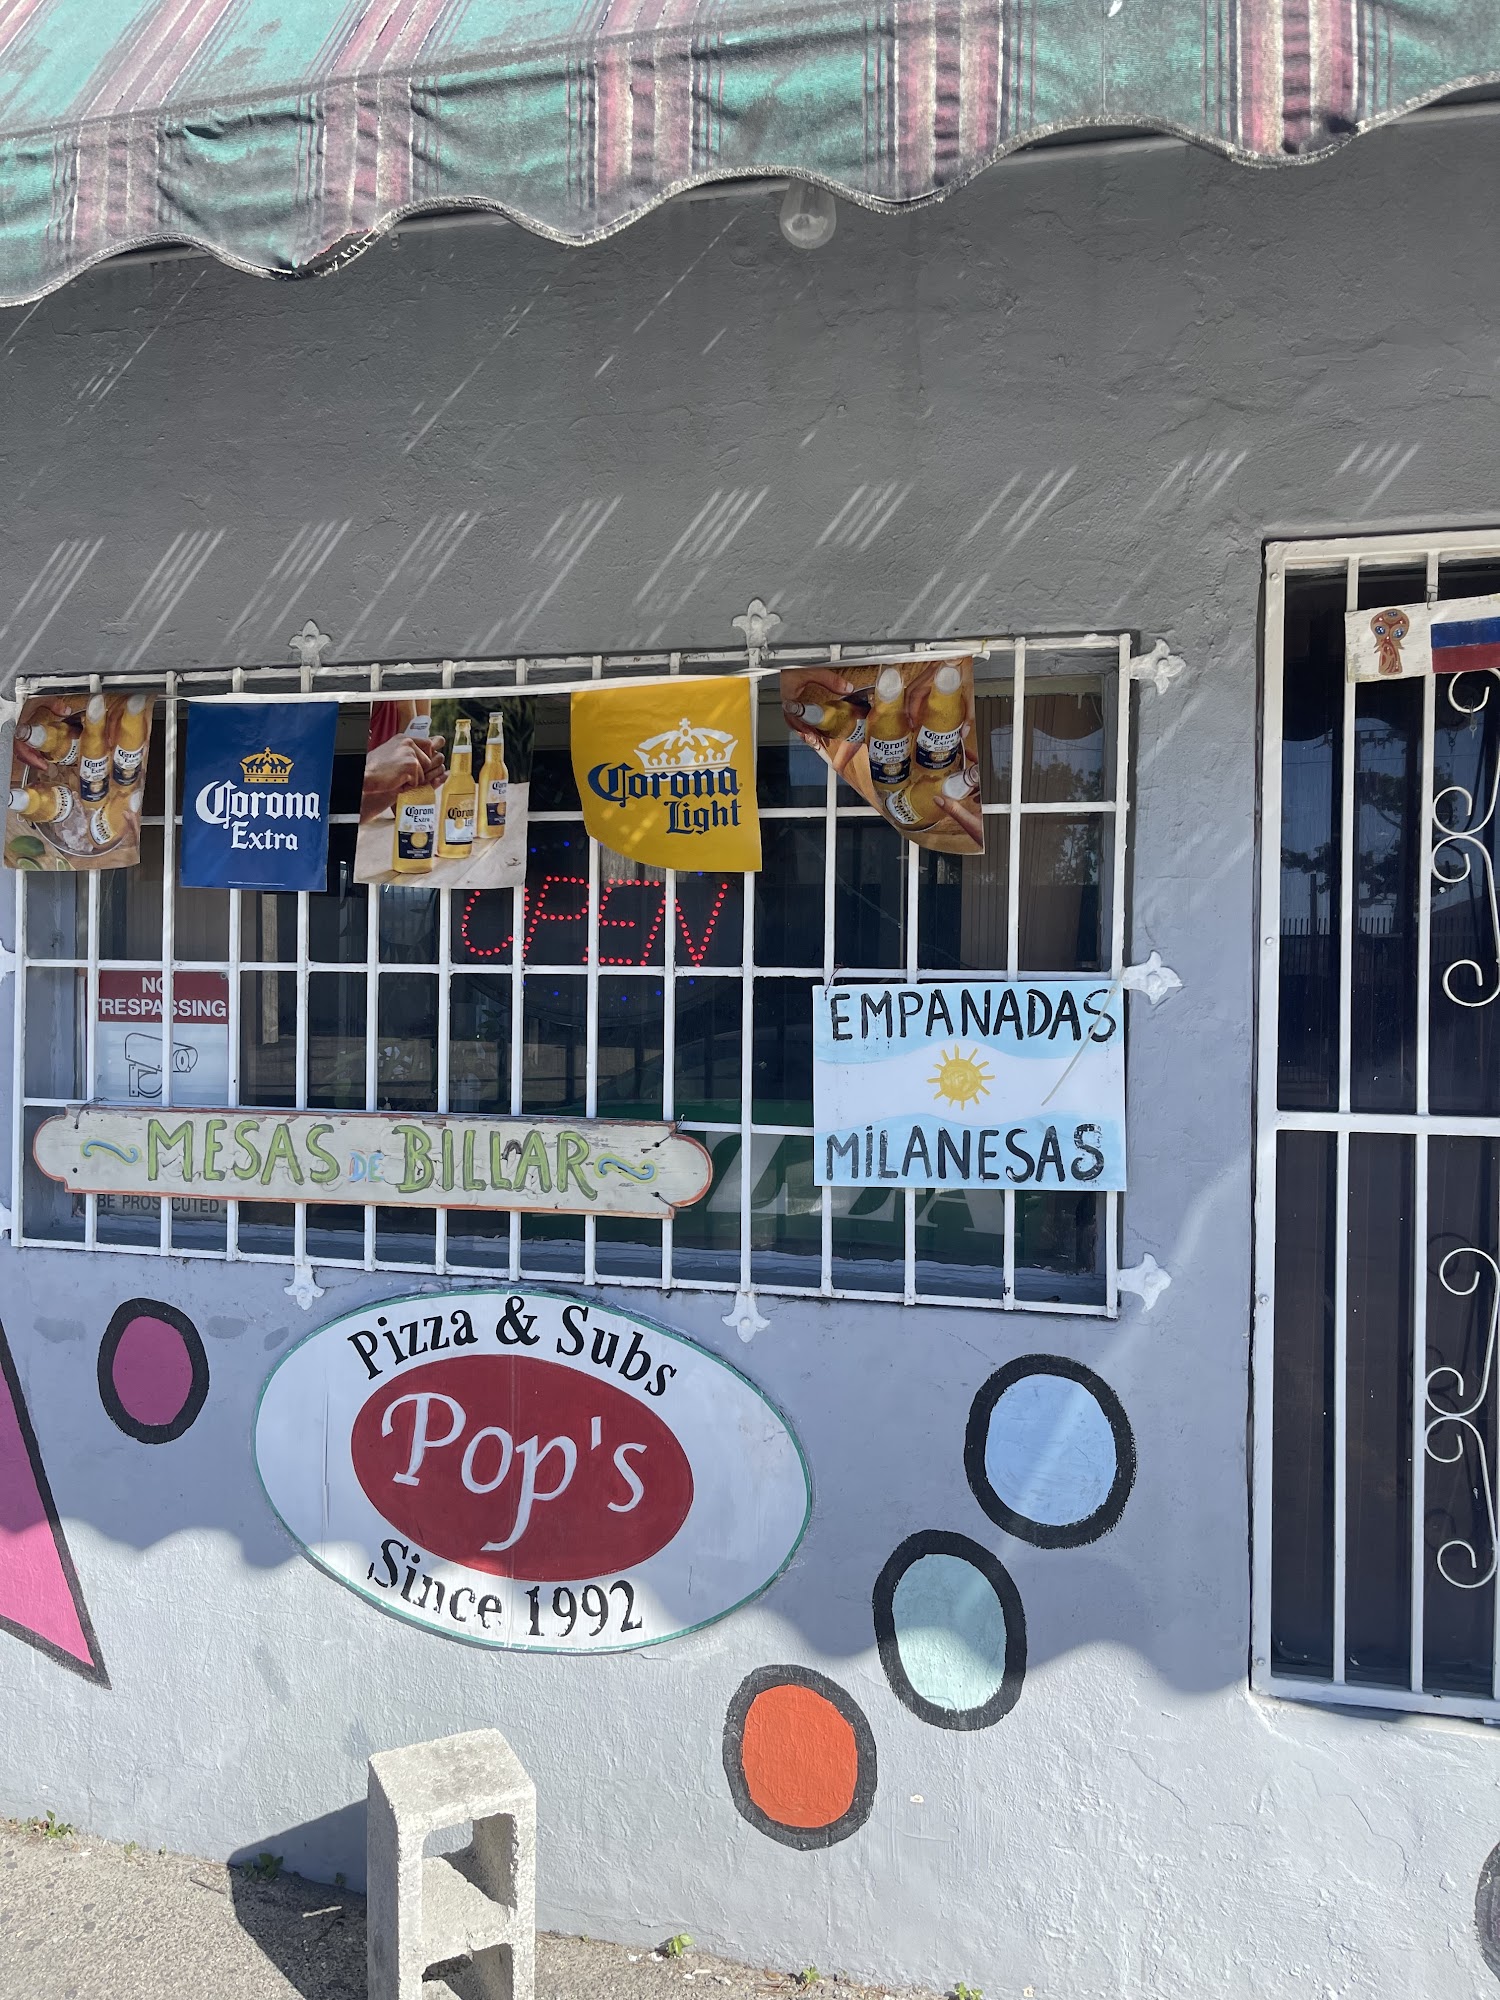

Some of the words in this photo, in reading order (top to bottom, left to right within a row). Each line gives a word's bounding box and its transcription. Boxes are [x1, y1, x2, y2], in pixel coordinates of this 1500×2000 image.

[196, 779, 321, 830] Corona
[588, 762, 741, 808] Corona
[230, 821, 299, 851] Extra
[665, 796, 742, 835] Light
[461, 875, 728, 968] OPEN
[99, 998, 227, 1017] RESPASSING
[830, 988, 1117, 1043] EMPANADAS
[147, 1118, 341, 1186] MESAS
[348, 1149, 386, 1183] DE
[392, 1124, 598, 1201] BILLAR
[97, 1194, 116, 1209] BE
[122, 1194, 219, 1213] PROSCUTED
[347, 1308, 477, 1380] Pizza
[495, 1295, 540, 1346] &
[556, 1305, 678, 1397] Subs
[381, 1391, 648, 1553] Pop's
[368, 1538, 503, 1630] Since
[524, 1579, 644, 1638] 1992
